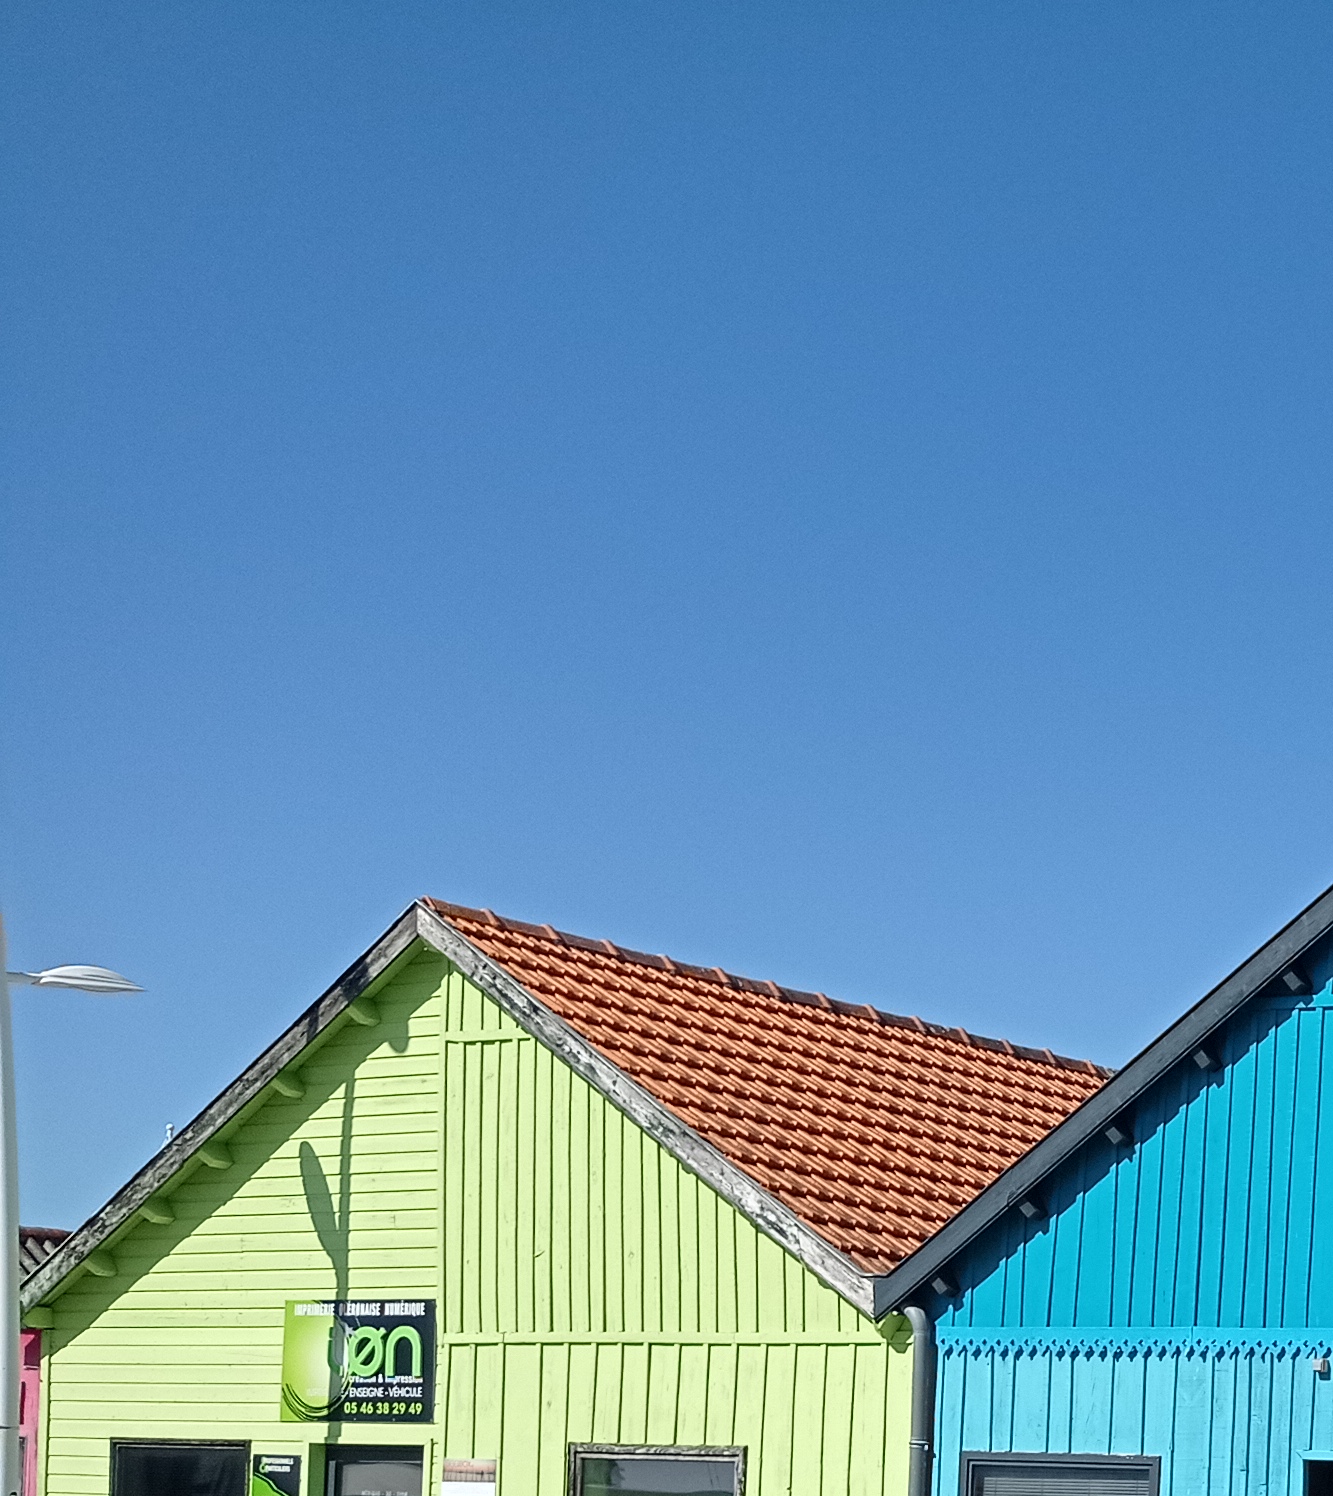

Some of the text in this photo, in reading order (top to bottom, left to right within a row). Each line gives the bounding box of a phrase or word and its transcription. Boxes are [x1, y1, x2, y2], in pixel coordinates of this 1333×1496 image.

[343, 1401, 423, 1415] 05 46 38 29 49
